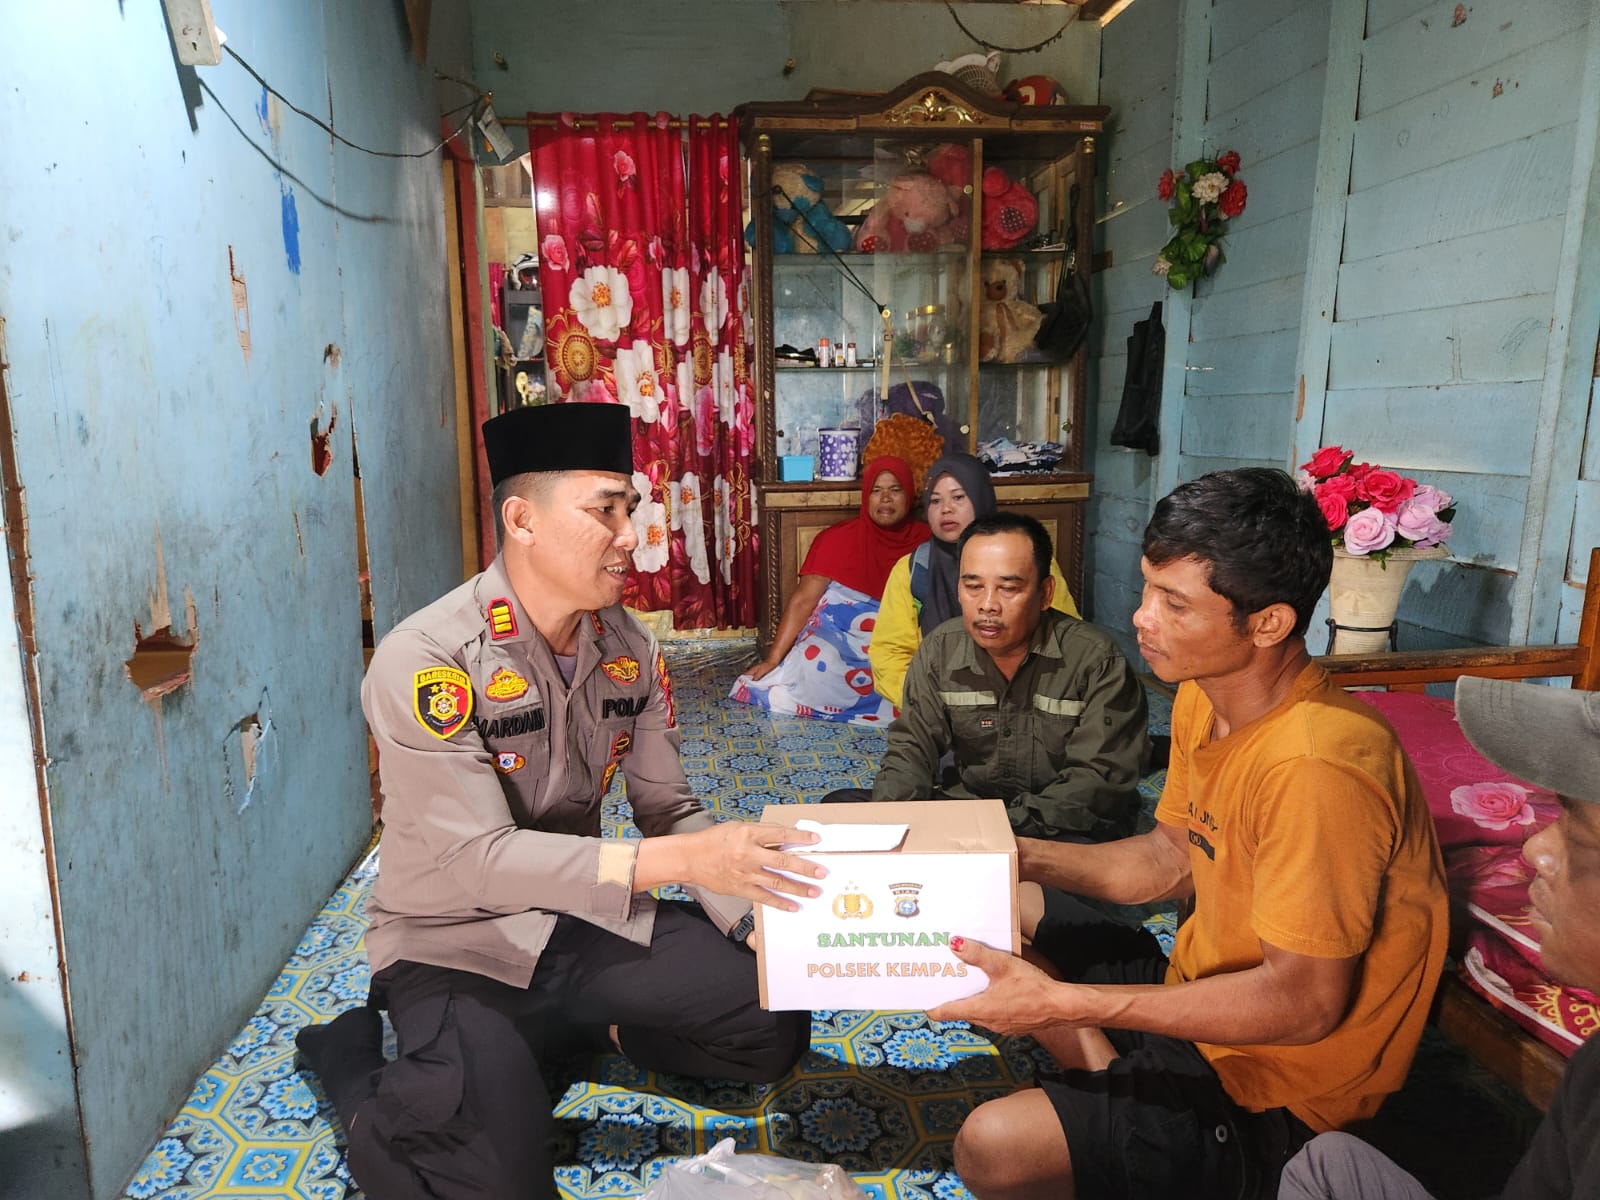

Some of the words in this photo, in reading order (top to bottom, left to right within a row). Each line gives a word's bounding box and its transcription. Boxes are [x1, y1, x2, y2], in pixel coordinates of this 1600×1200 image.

[817, 932, 950, 947] SANTUNAN
[807, 963, 881, 977] POLSEK
[886, 963, 968, 977] KEMPAS
